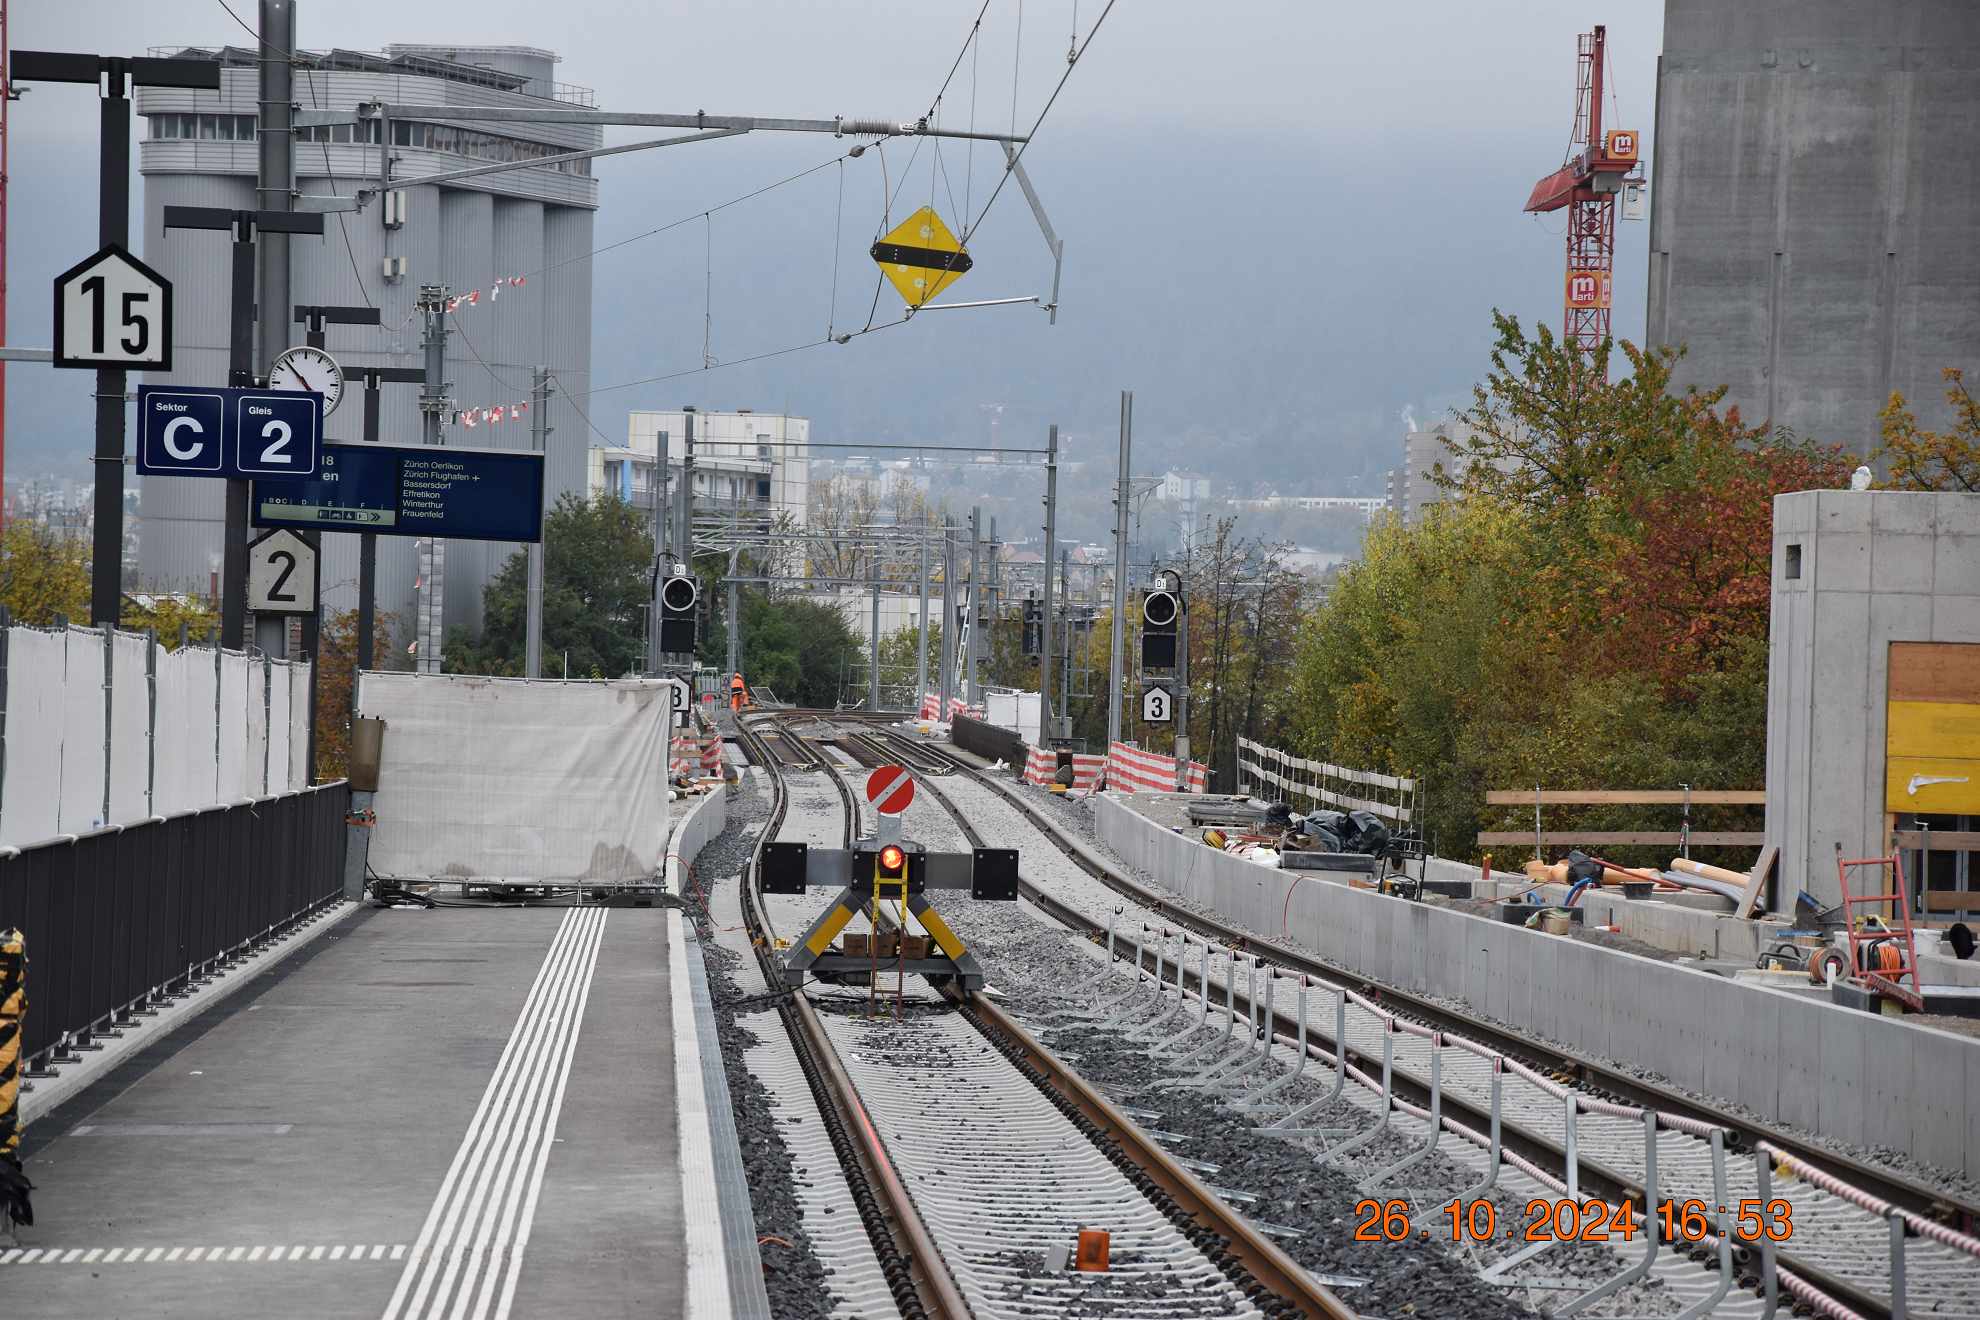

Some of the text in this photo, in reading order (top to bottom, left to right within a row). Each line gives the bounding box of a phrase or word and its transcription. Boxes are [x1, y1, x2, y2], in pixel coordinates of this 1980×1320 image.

[80, 275, 150, 355] 15
[155, 402, 188, 412] Sektor
[249, 406, 273, 416] Gleis
[163, 416, 204, 461] C
[260, 419, 292, 464] 2
[403, 460, 464, 471] Zürich Oerlikon
[403, 470, 470, 481] Zürich Flughafen
[403, 480, 451, 489] Bassersdorf
[403, 490, 440, 499] Effretikon
[402, 500, 444, 509] Winterthur
[402, 509, 444, 518] Frauenfeld
[267, 550, 296, 602] 2
[1151, 696, 1163, 718] 3
